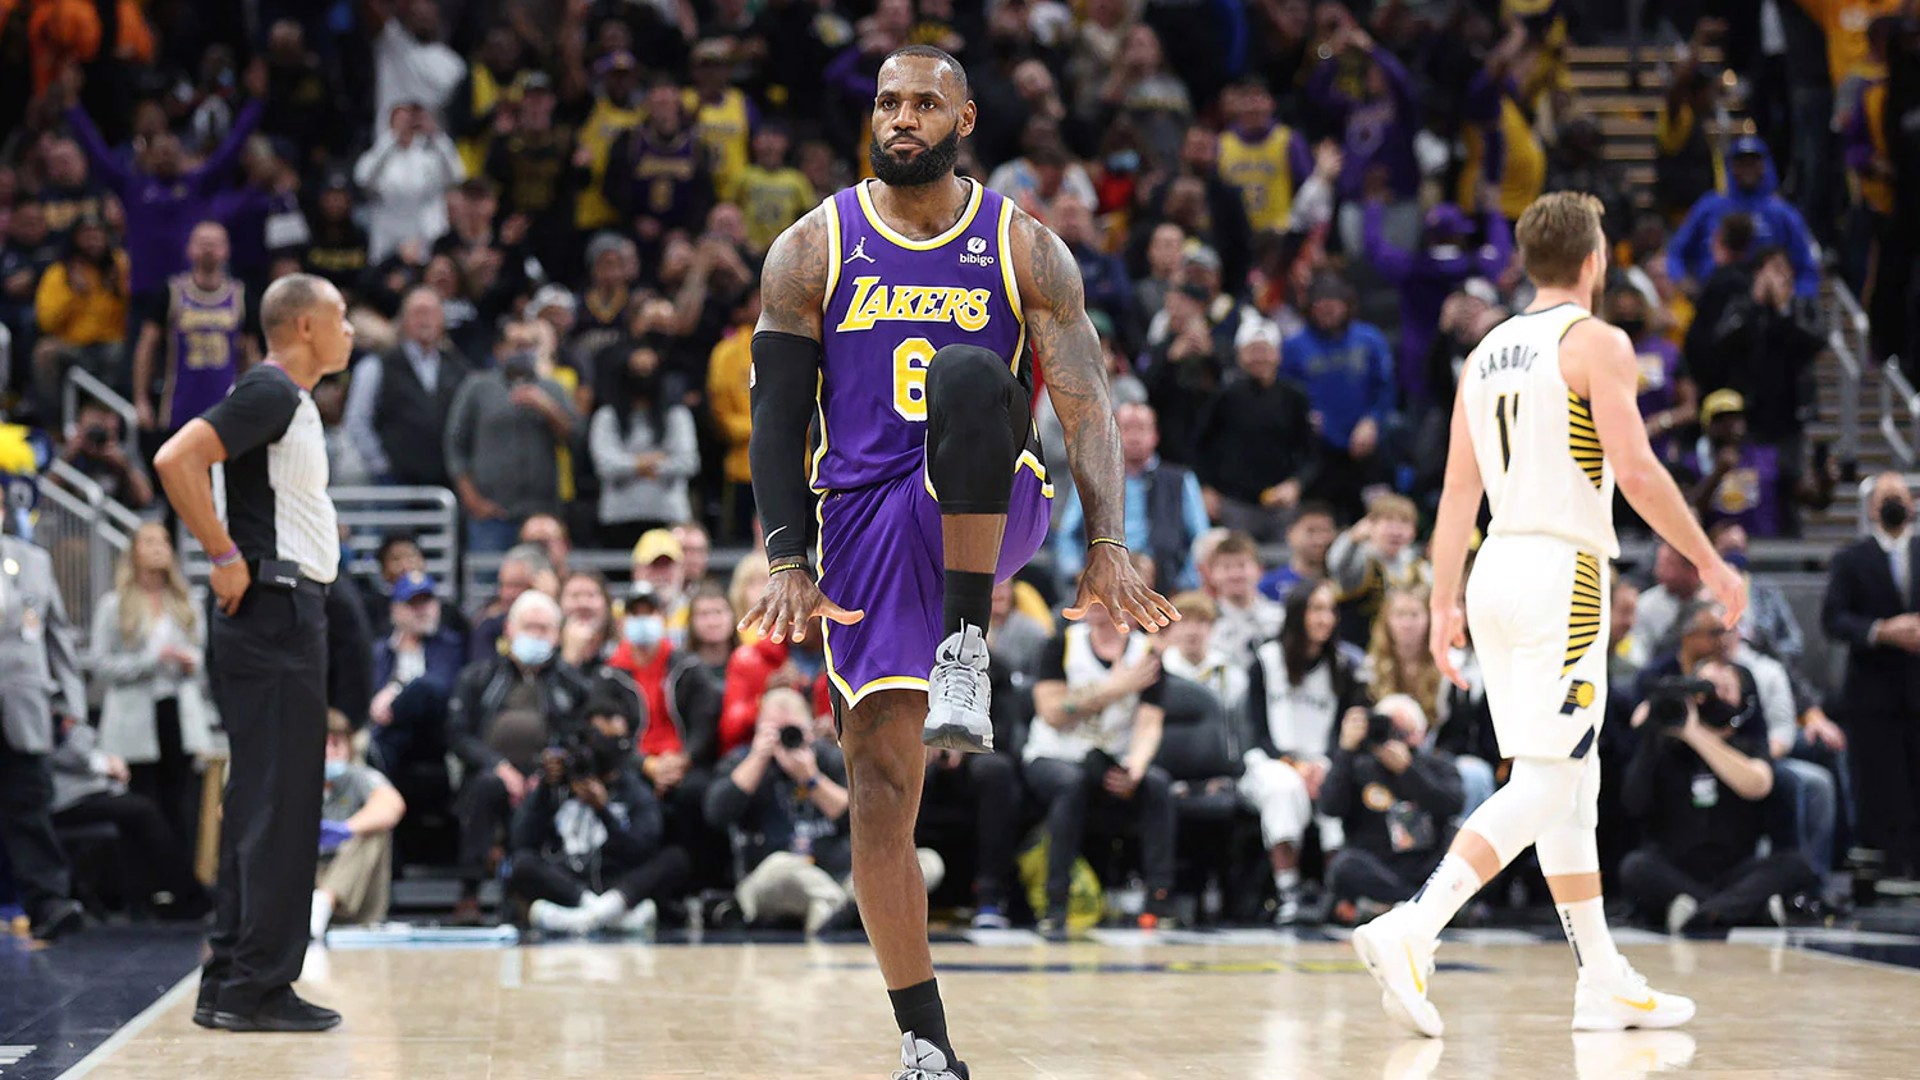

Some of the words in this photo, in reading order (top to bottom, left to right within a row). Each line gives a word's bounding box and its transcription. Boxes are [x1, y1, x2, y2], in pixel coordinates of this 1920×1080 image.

[960, 253, 994, 267] bibigo
[836, 275, 991, 333] LAKERS
[893, 337, 938, 422] 6
